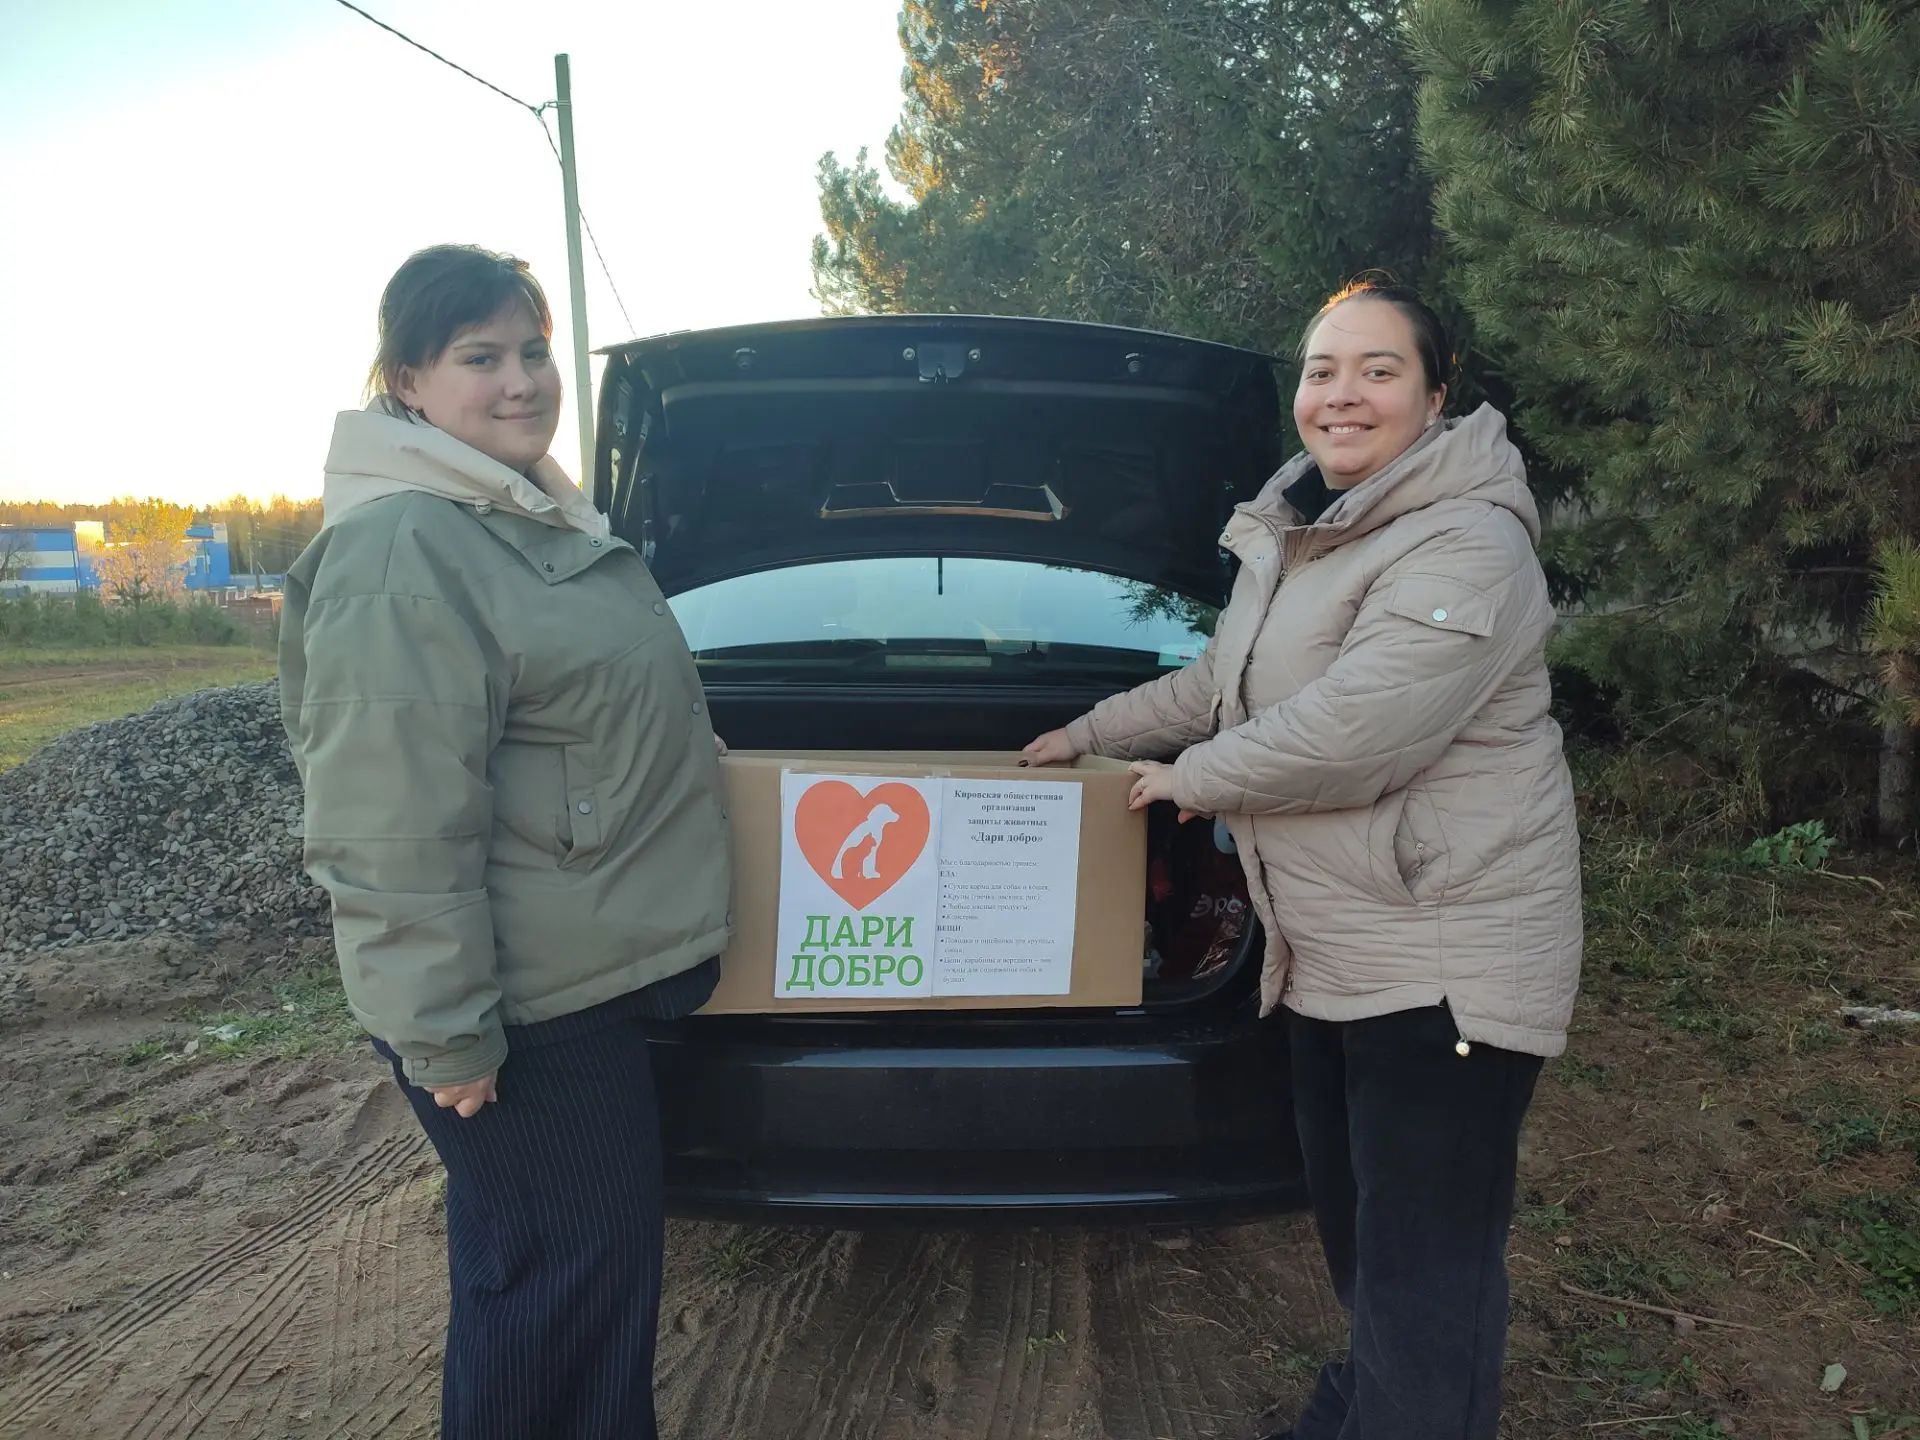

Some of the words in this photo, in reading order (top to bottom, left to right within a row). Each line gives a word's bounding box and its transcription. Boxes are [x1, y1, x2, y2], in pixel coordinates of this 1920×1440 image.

[954, 789, 1001, 800] Кировская
[1003, 791, 1064, 801] общественная
[981, 804, 1036, 813] организация
[968, 818, 1001, 827] защиты
[1003, 819, 1048, 827] животных
[970, 831, 1004, 845] «Дари
[1006, 832, 1043, 845] добро»
[800, 915, 915, 952] ДАРИ
[785, 954, 924, 991] ДОБРО
